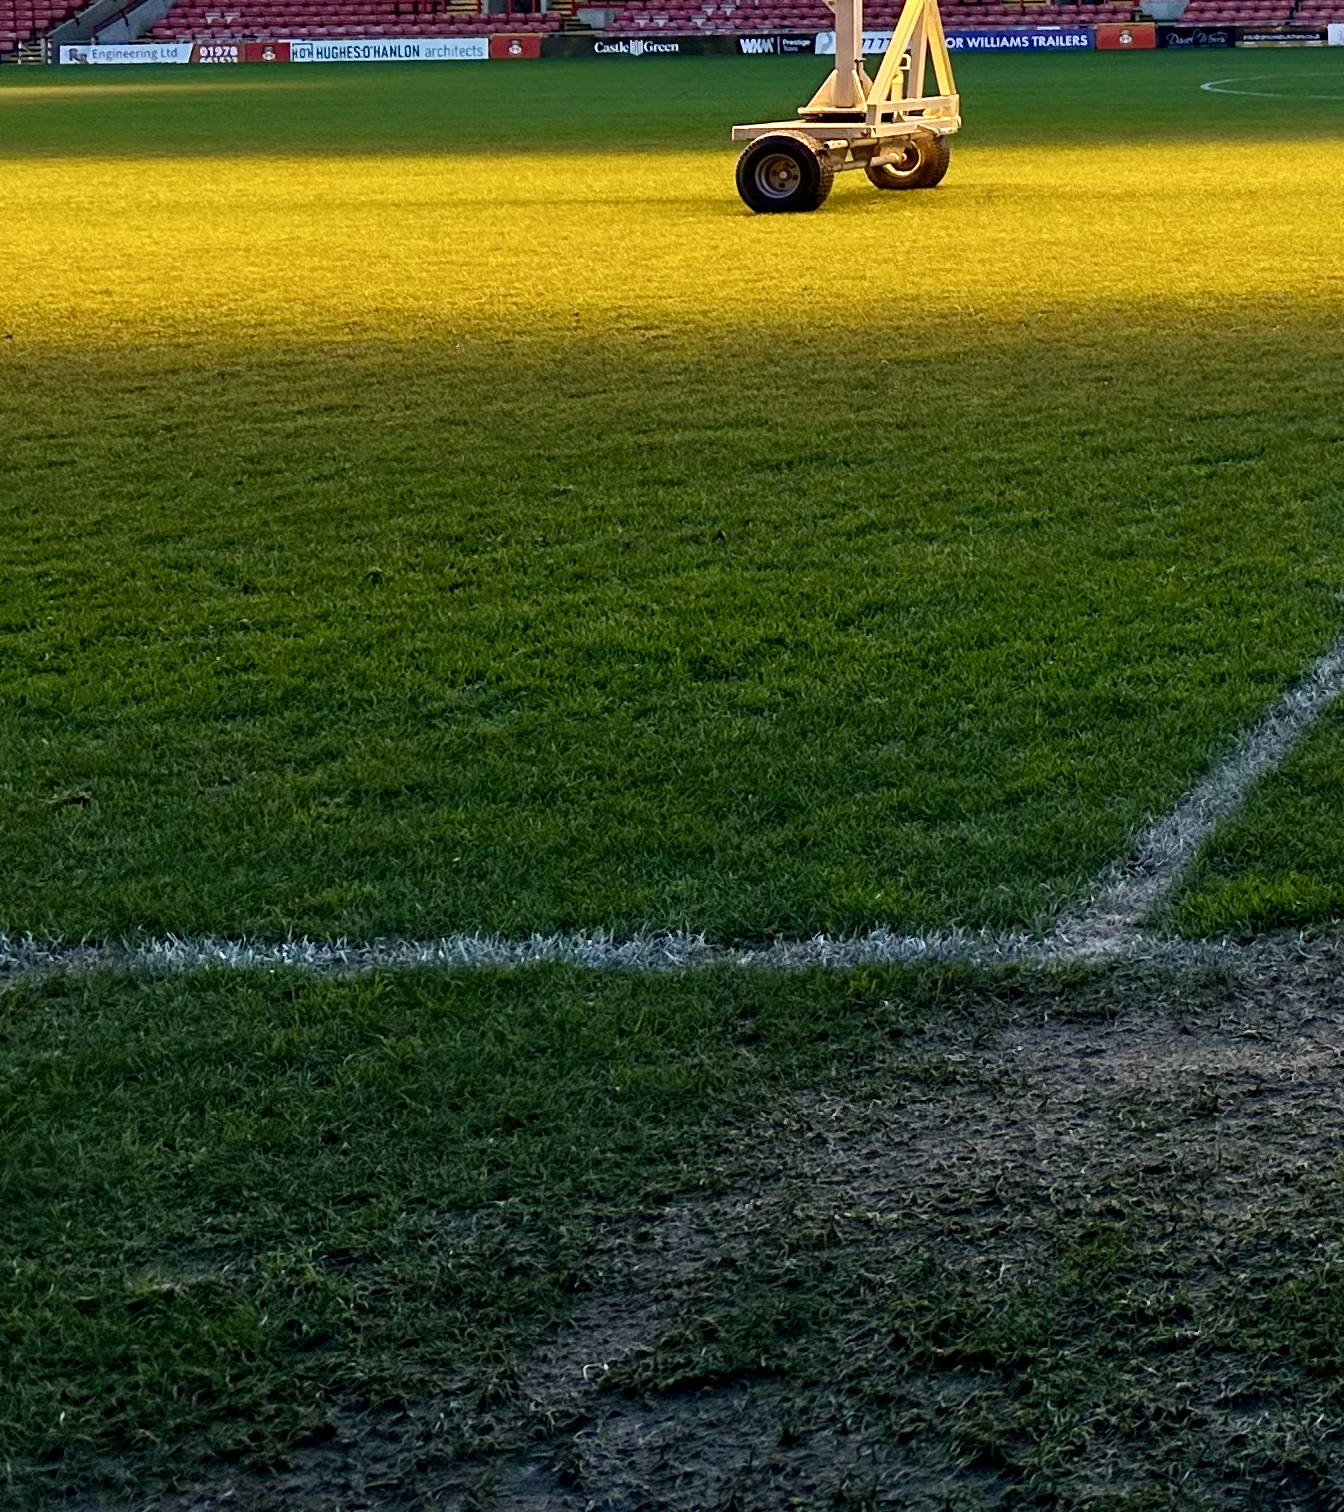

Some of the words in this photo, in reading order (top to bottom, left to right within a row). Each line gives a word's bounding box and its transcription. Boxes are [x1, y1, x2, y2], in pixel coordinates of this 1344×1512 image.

[594, 40, 629, 53] Castle
[644, 40, 679, 53] Green
[966, 36, 1029, 48] WILLIAMS
[1031, 35, 1088, 47] TRAILERS
[92, 48, 158, 61] Engineering
[160, 47, 178, 58] Ltd
[200, 46, 238, 57] 01978
[425, 43, 484, 57] architects
